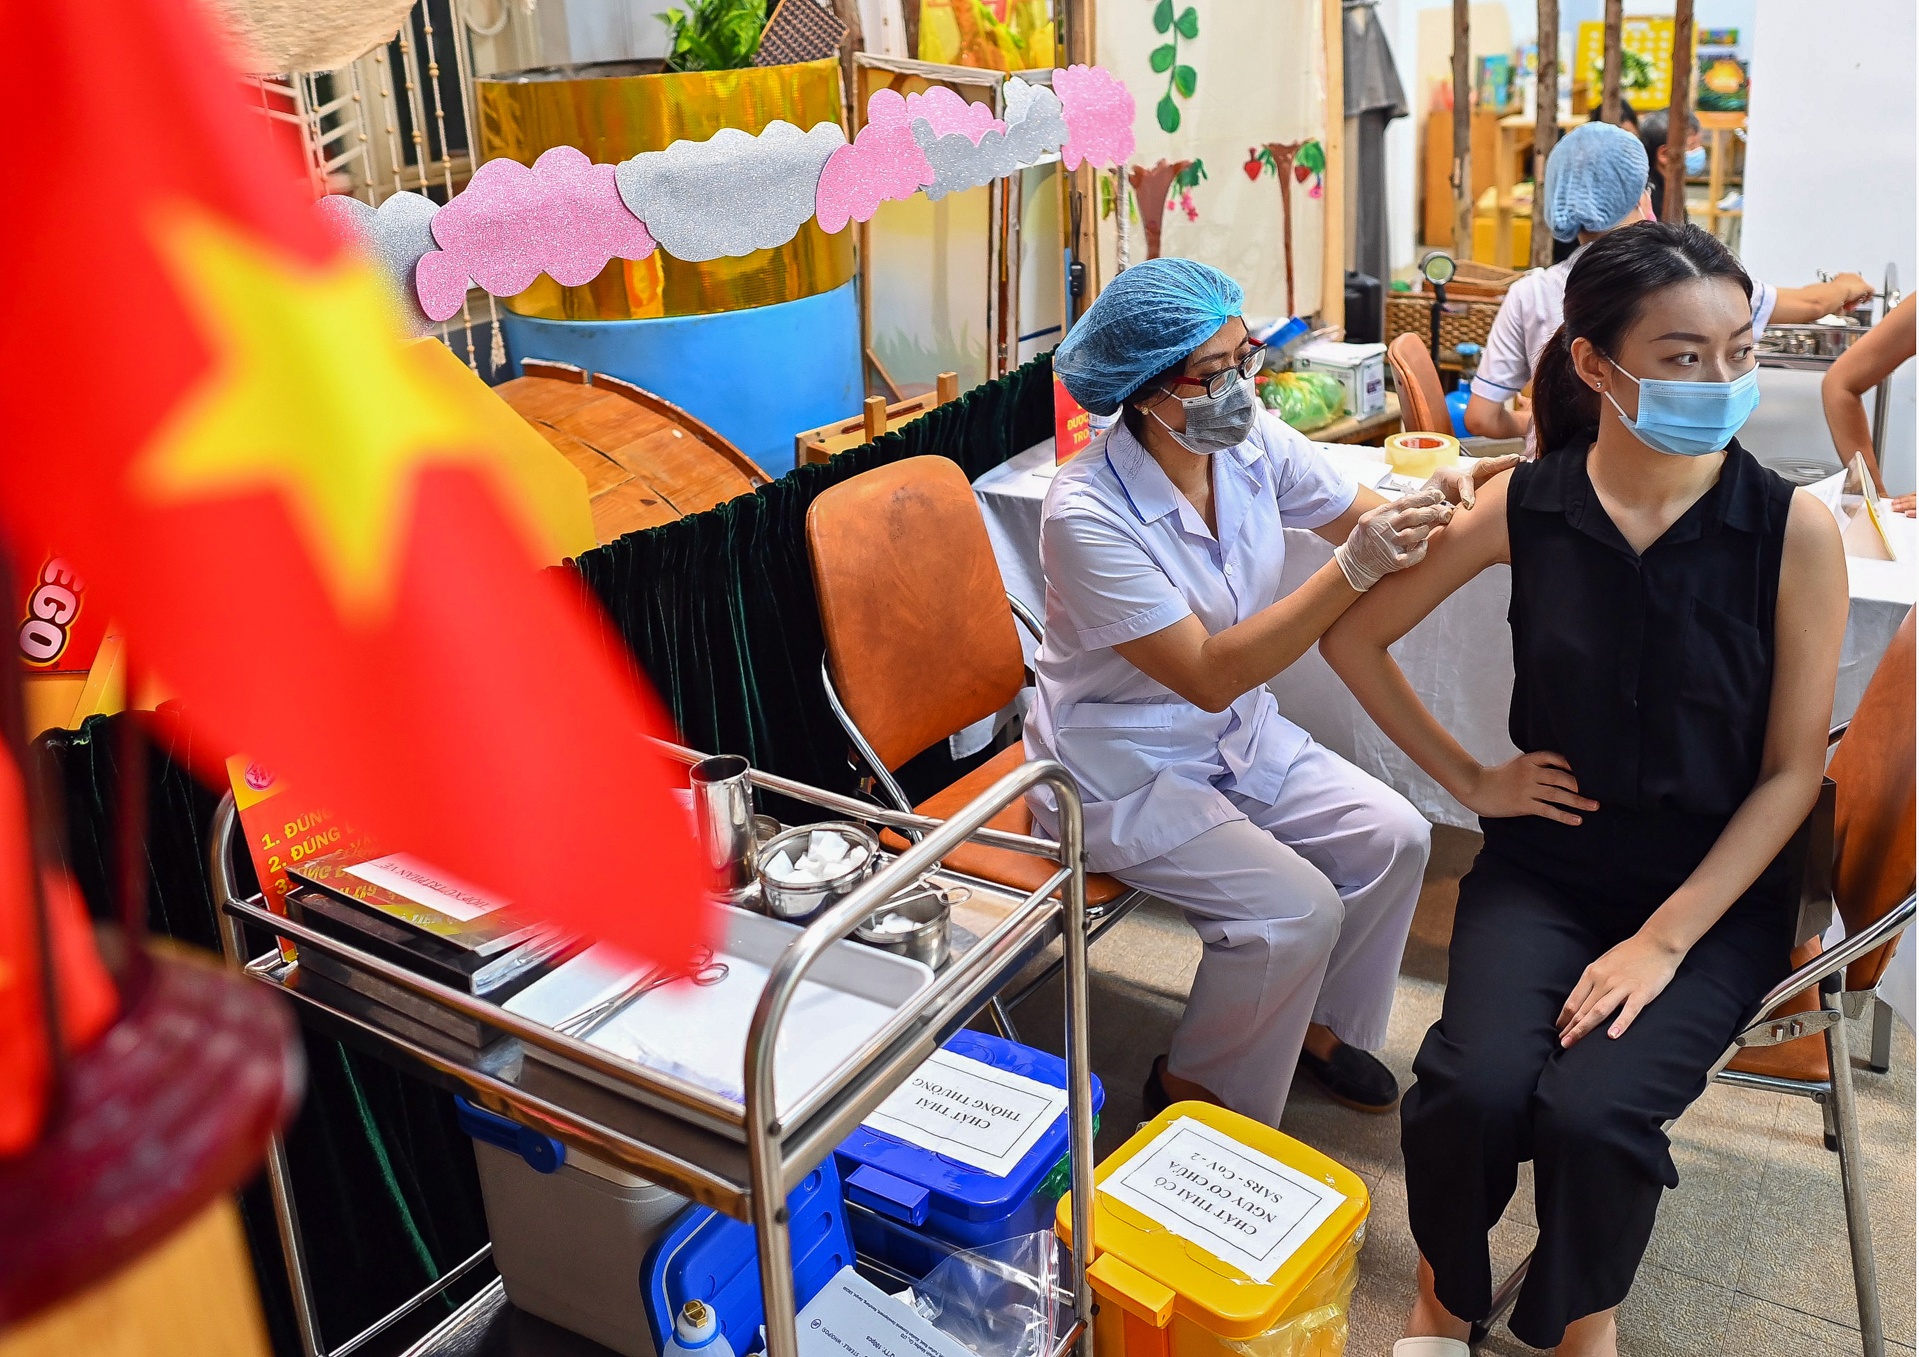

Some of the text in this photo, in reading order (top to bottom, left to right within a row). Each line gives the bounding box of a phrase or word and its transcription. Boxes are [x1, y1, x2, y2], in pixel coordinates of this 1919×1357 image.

[1073, 428, 1090, 444] TRO
[19, 557, 85, 659] EGO
[261, 833, 281, 851] 1.
[268, 855, 287, 873] 2.
[290, 826, 341, 862] ĐÚNG
[912, 1078, 1021, 1122] THÔNG THƯỜNG
[1190, 1152, 1201, 1161] 2
[1206, 1161, 1235, 1180] CoV
[1154, 1176, 1177, 1191] CÓ
[1168, 1161, 1278, 1223] NGUY CƠ CHỨA
[1243, 1179, 1283, 1203] SARS
[1176, 1188, 1213, 1213] THẢI
